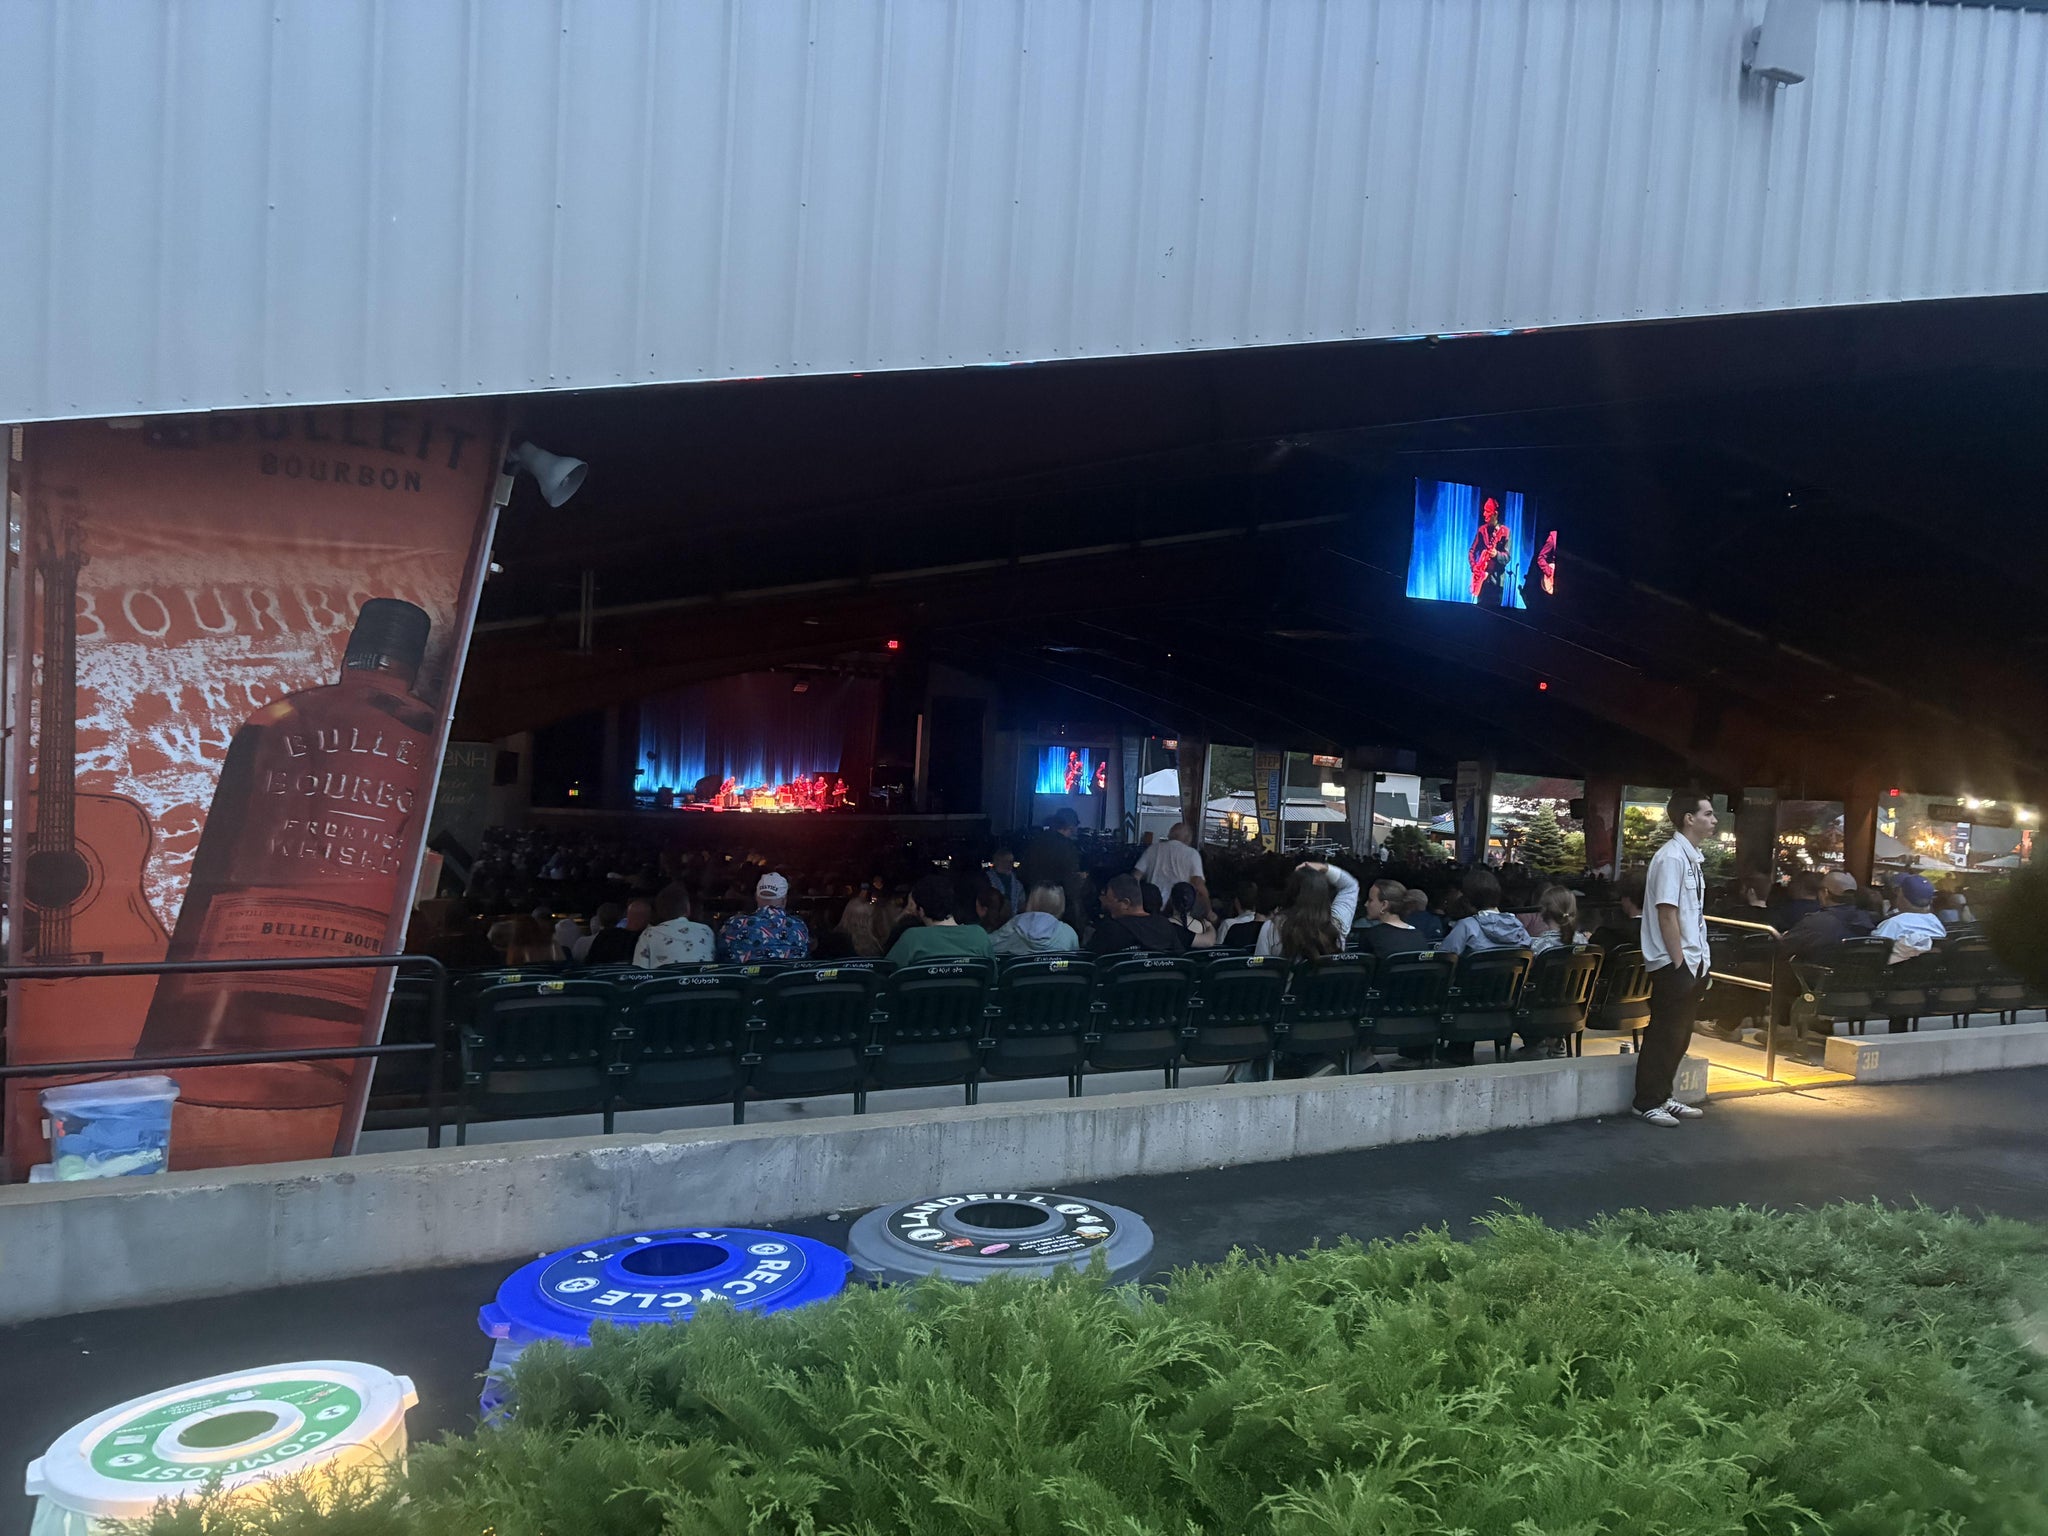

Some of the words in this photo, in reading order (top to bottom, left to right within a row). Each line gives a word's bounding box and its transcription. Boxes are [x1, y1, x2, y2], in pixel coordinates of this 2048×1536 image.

[259, 452, 422, 492] BOURBON
[261, 921, 338, 941] BULLEIT
[690, 976, 720, 985] Kubota
